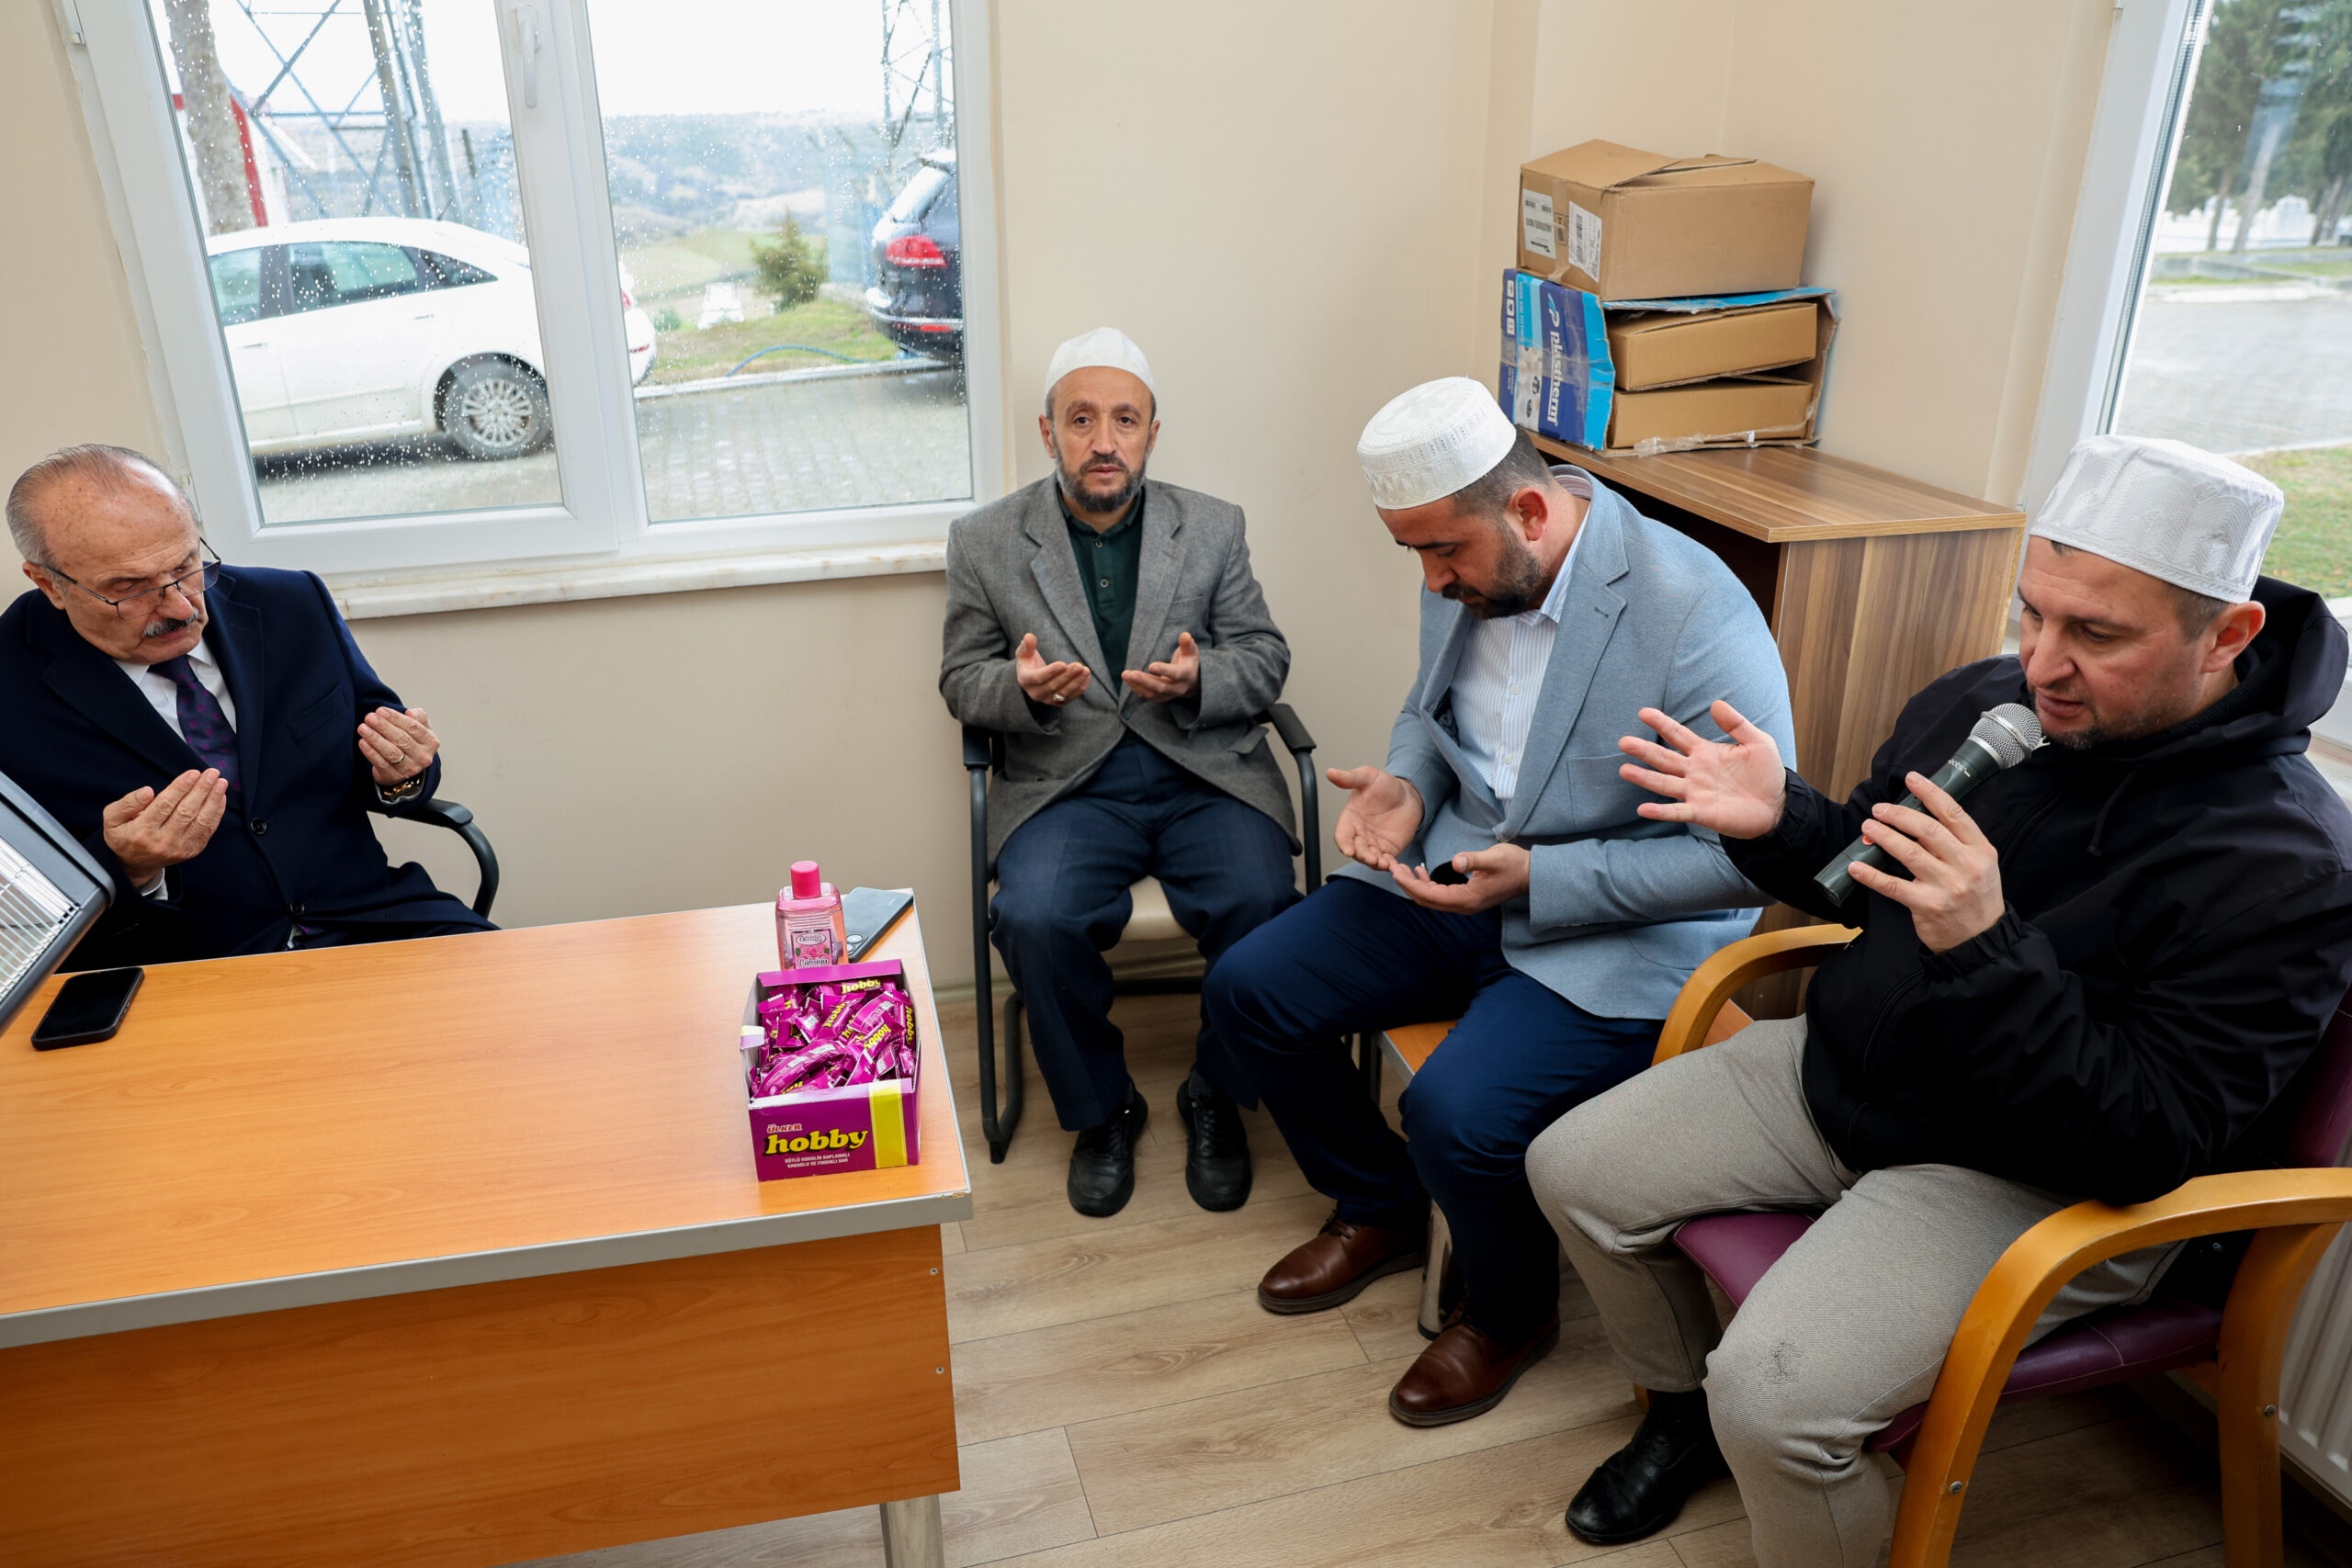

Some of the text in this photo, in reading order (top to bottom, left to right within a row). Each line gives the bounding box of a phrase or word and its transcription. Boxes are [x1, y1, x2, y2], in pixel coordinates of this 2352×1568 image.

[1547, 331, 1564, 426] plastherm
[842, 978, 881, 994] hobby
[767, 1122, 803, 1134] ÜLKER
[763, 1128, 868, 1156] hobby
